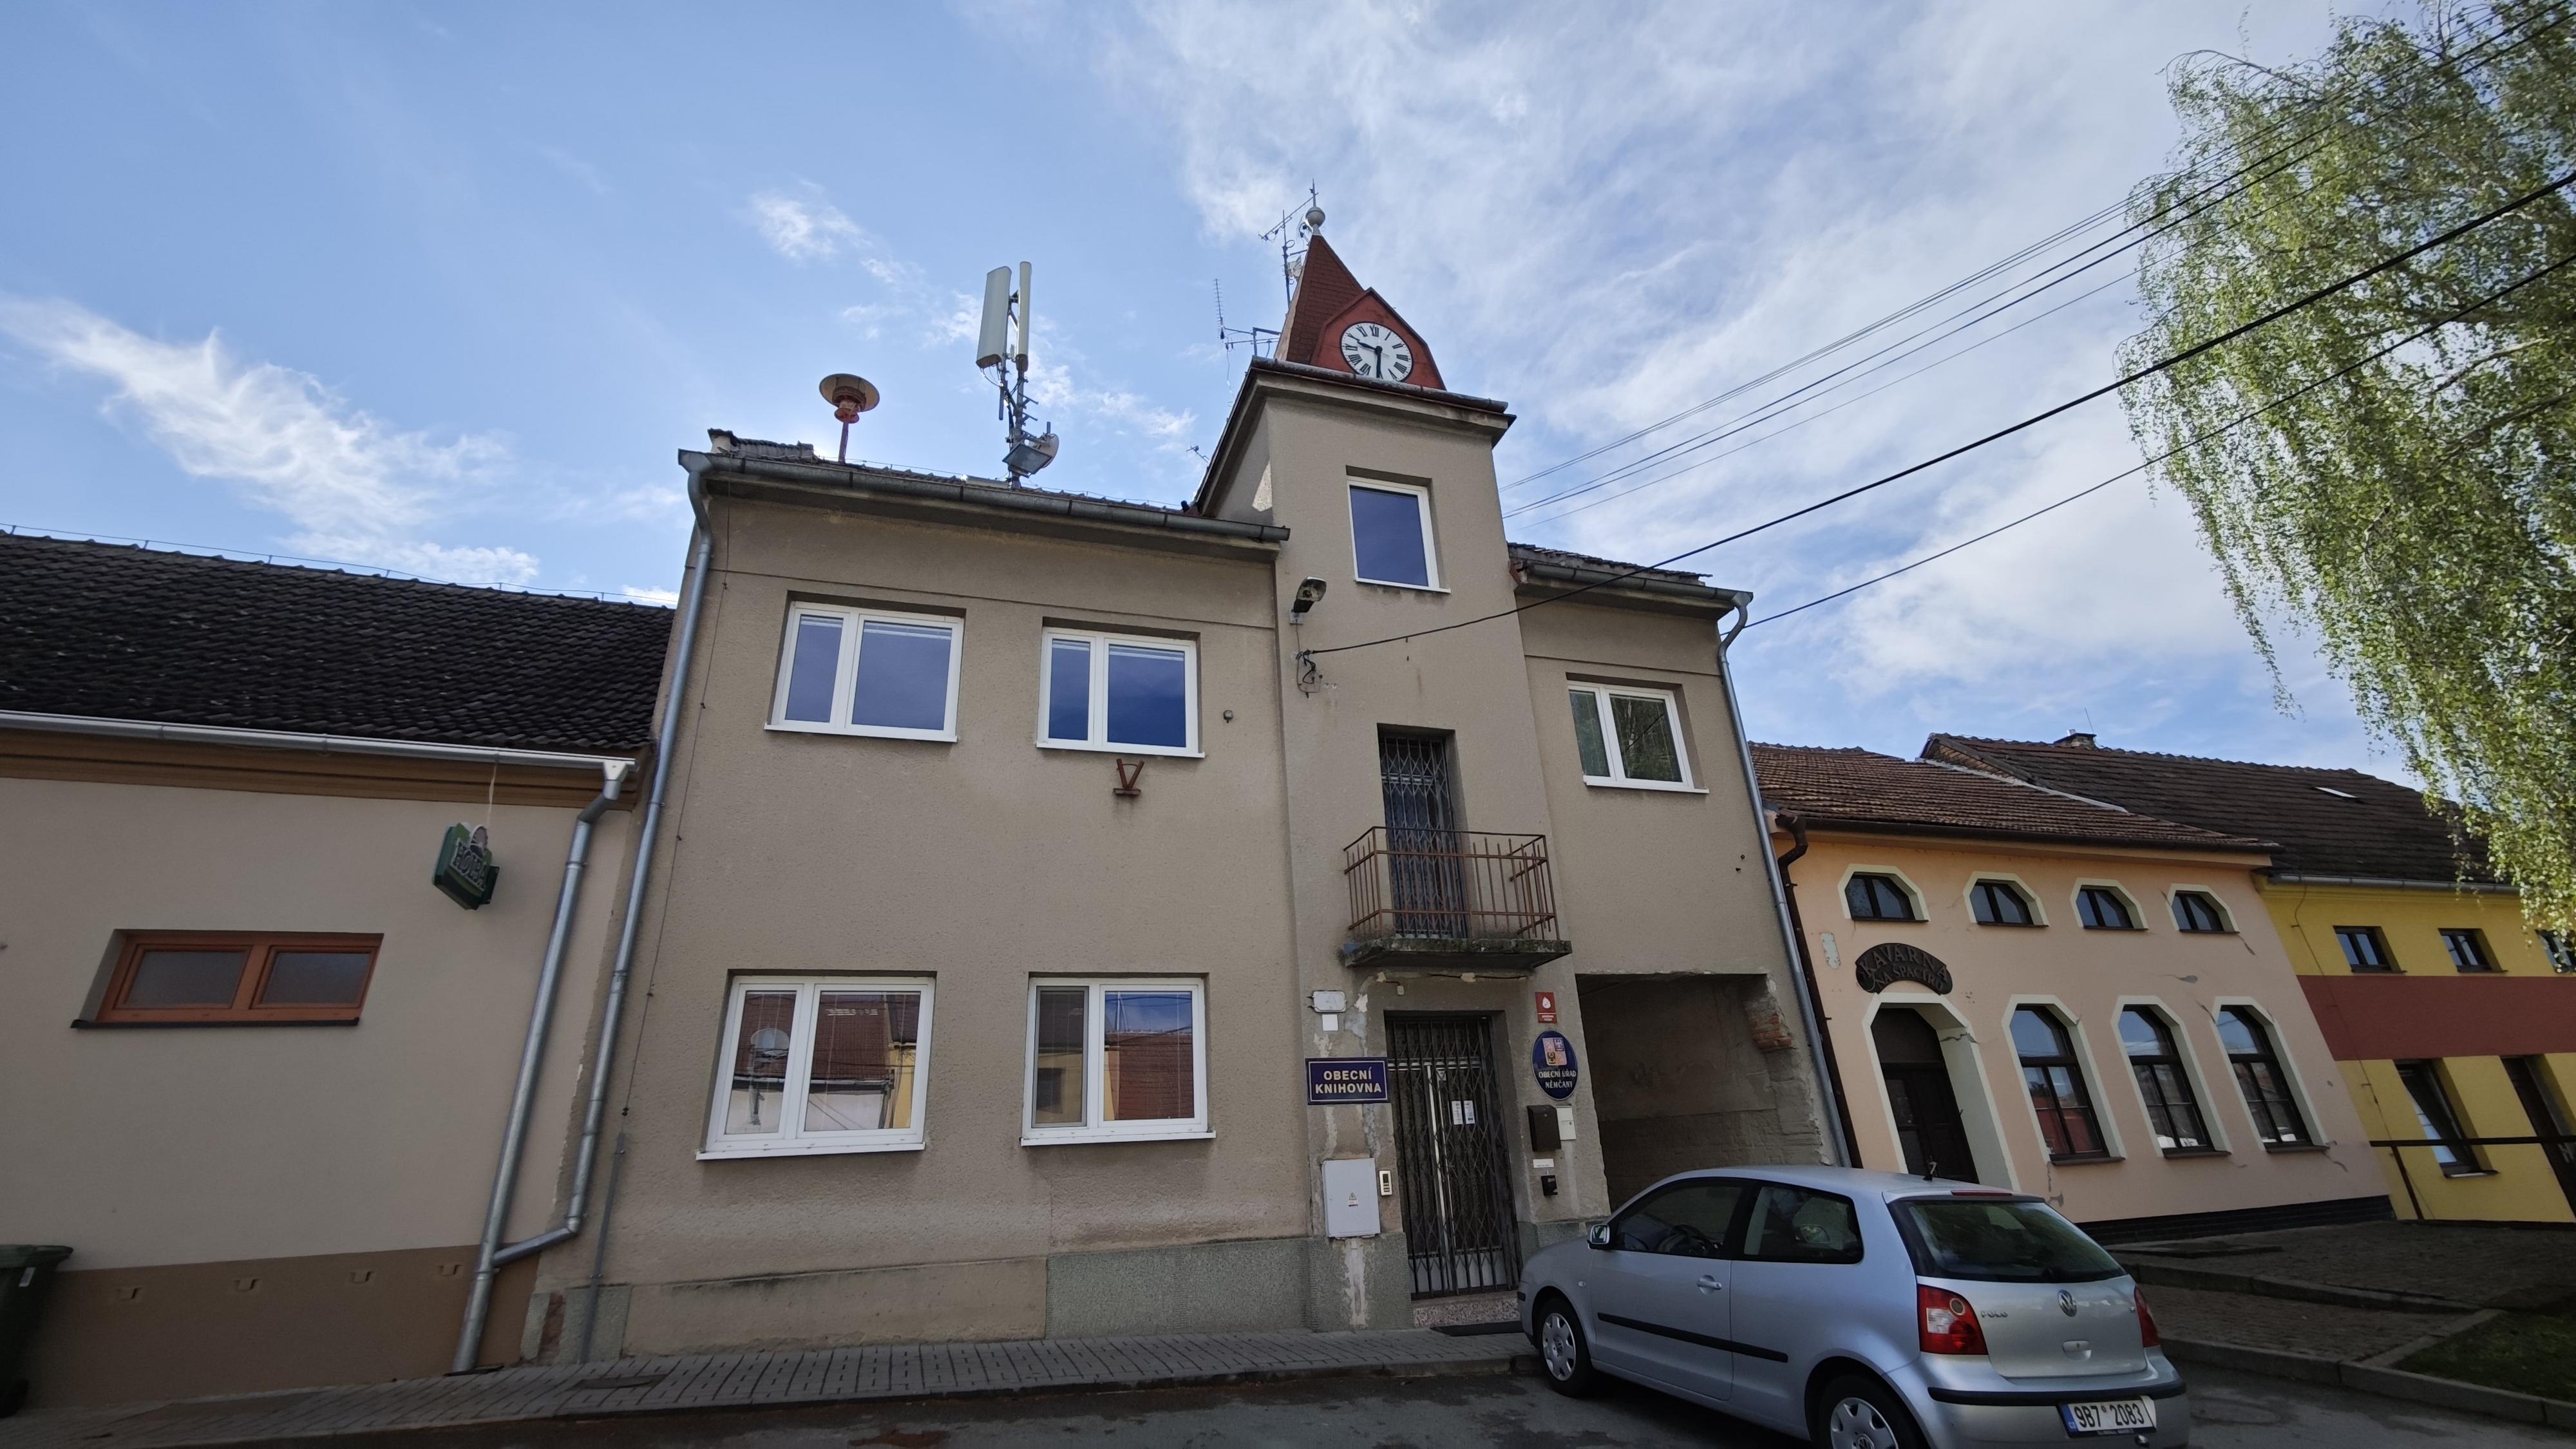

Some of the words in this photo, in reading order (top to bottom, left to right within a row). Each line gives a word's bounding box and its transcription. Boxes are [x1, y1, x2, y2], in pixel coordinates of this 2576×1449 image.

[1876, 972, 1893, 989] NA
[1323, 1066, 1372, 1080] OBECNÍ
[1538, 1069, 1561, 1078] OBECNÍ
[1315, 1083, 1382, 1094] KNIHOVNA
[1545, 1079, 1573, 1089] NĚMČANY
[1980, 1309, 2009, 1318] POLO
[2074, 1405, 2101, 1428] 9B7
[2110, 1403, 2145, 1426] 2083
